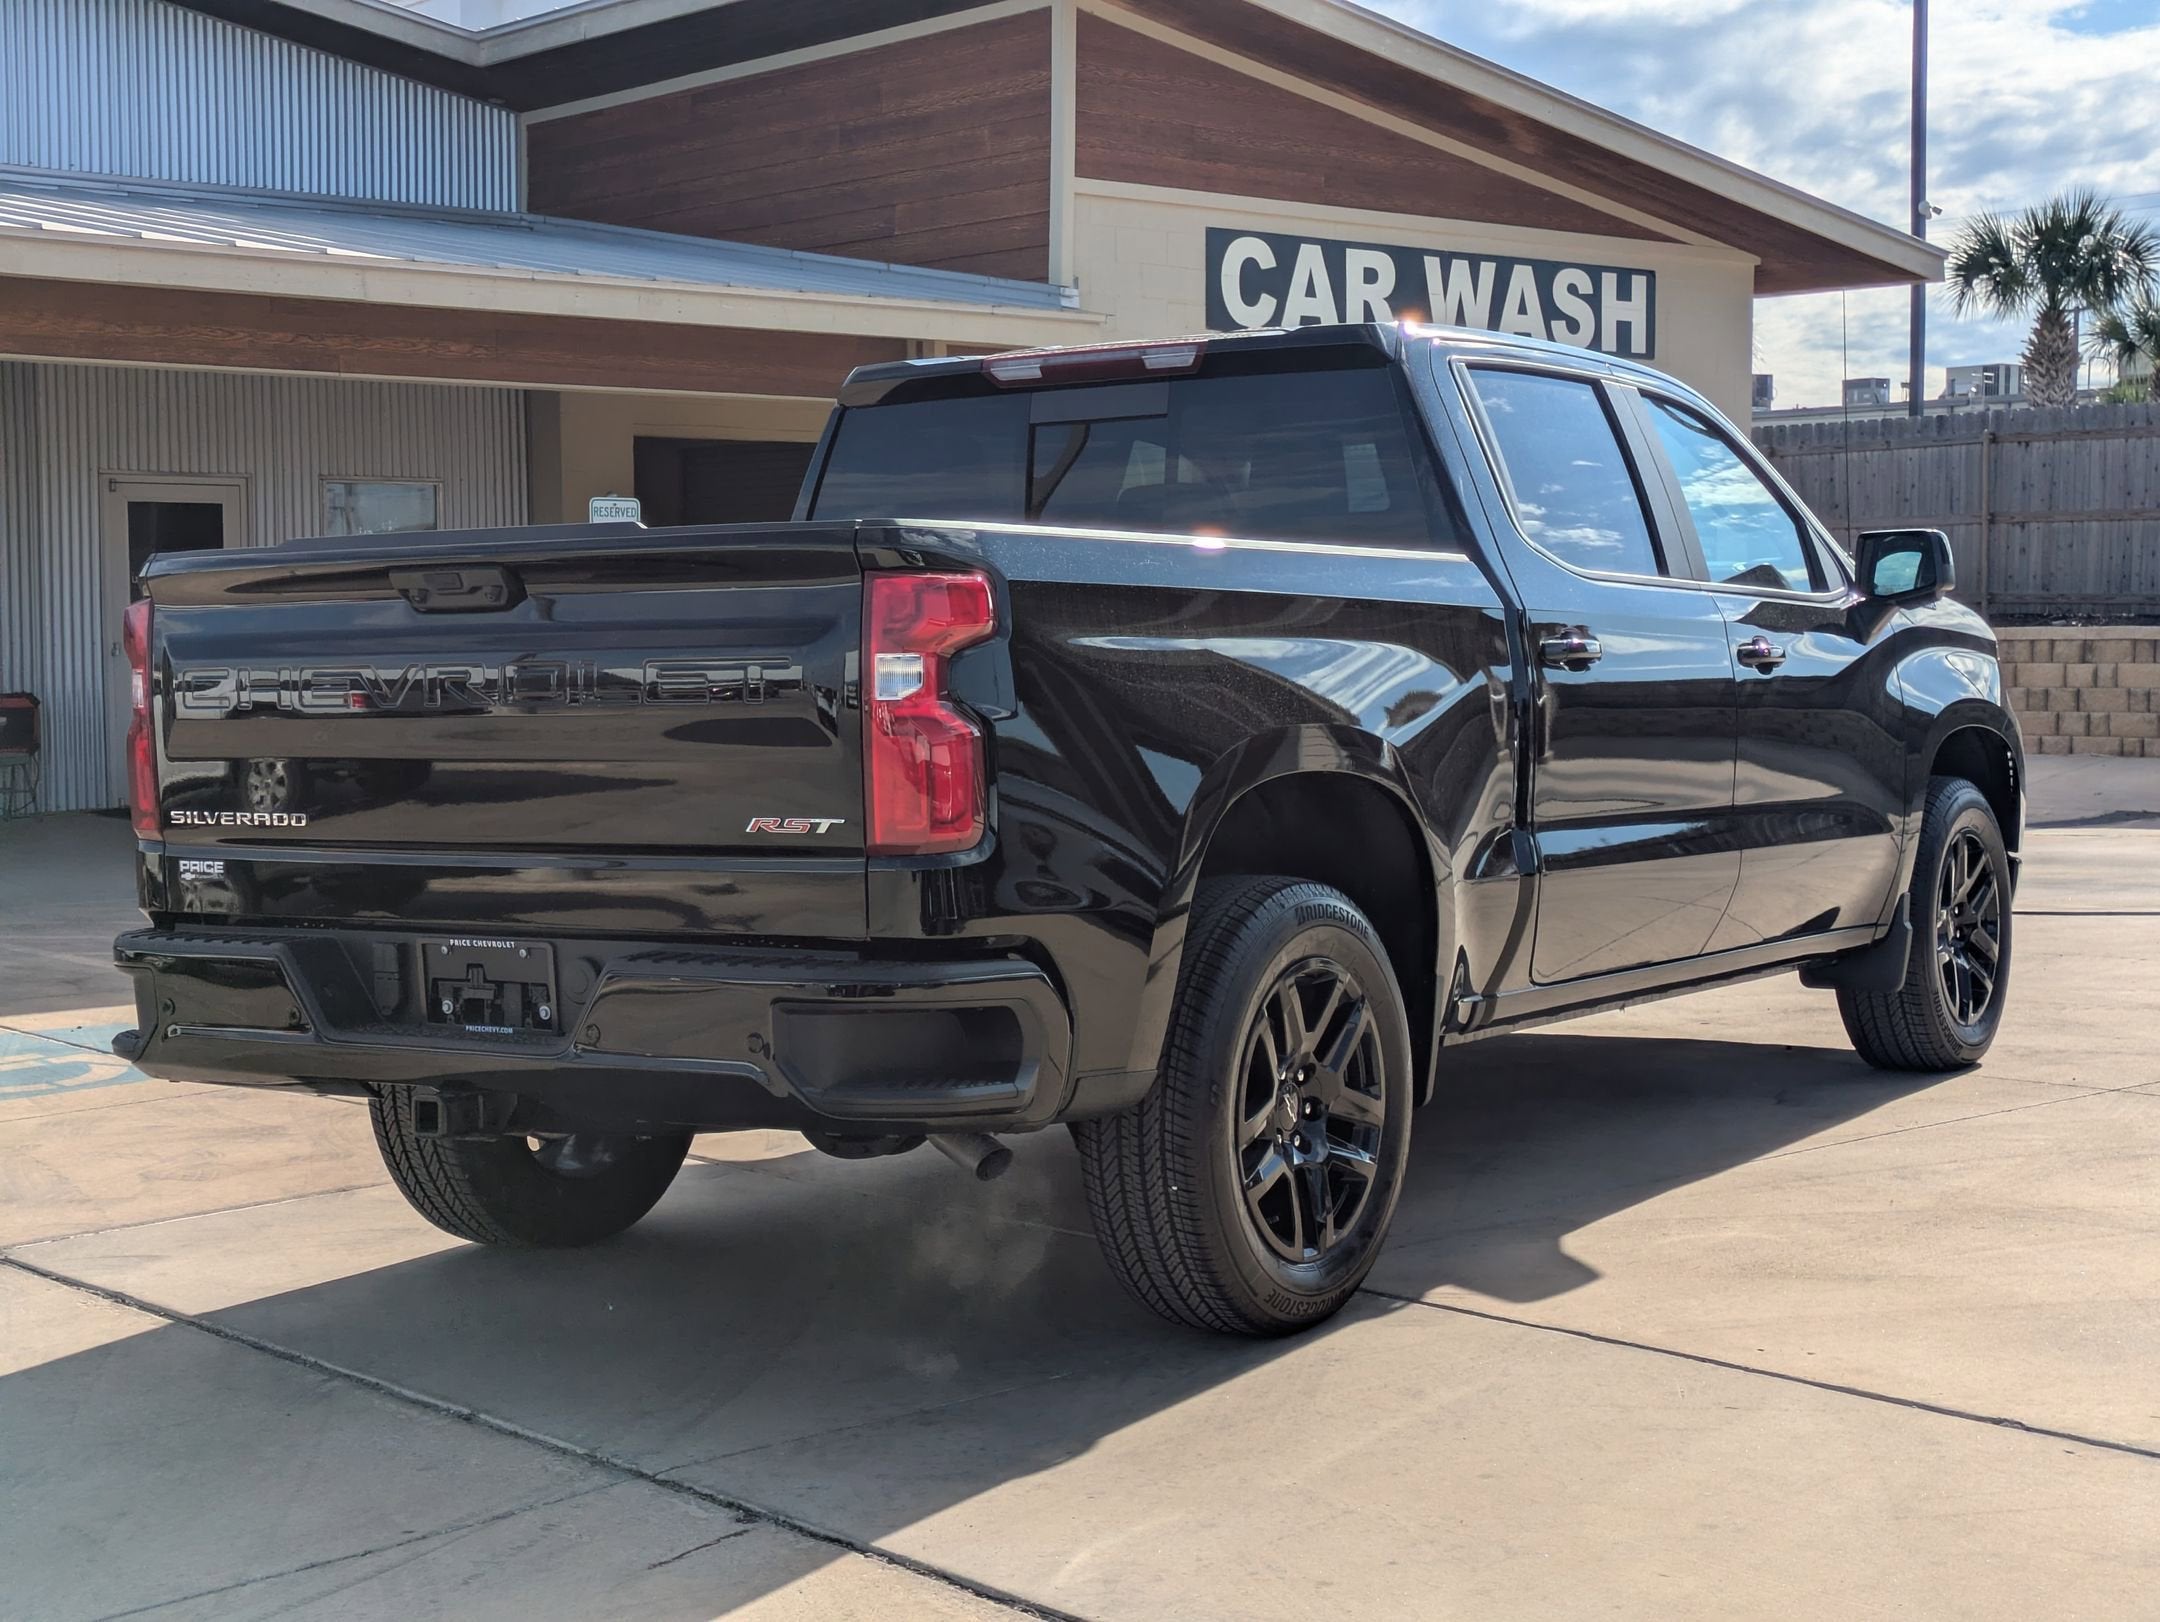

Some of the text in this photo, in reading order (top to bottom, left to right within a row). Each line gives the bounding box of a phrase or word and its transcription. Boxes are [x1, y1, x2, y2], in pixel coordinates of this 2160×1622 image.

[1220, 236, 1648, 354] CAR WASH
[593, 506, 637, 518] RESERVED
[182, 656, 793, 710] CHEVROLET
[170, 810, 307, 827] SILVERADO
[745, 817, 845, 834] RST
[179, 860, 224, 873] PRICE
[1294, 903, 1371, 939] BRIDGESTONE
[450, 939, 515, 948] PRICE CHEVROLET
[465, 1025, 513, 1034] PRICECHEVY.COM
